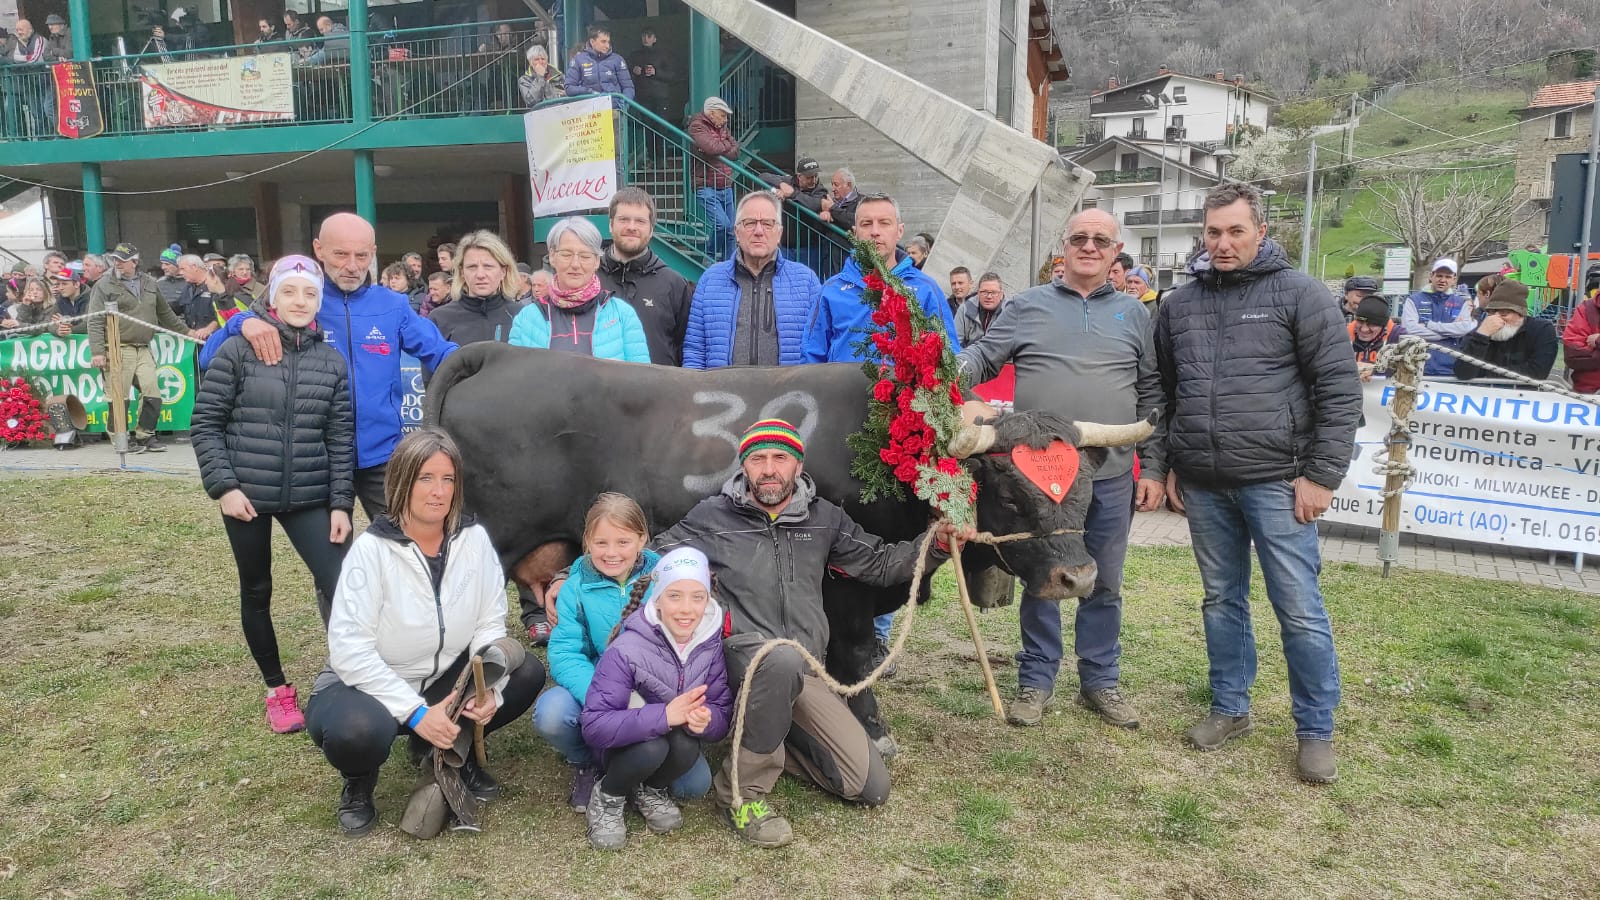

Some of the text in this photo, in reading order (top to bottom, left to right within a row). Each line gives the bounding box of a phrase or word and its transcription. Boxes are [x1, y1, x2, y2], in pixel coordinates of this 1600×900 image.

[1474, 478, 1571, 501] MILWAUKEE
[1414, 504, 1465, 527] Quart
[1469, 510, 1508, 535] (AO)
[1519, 517, 1552, 539] Tel.
